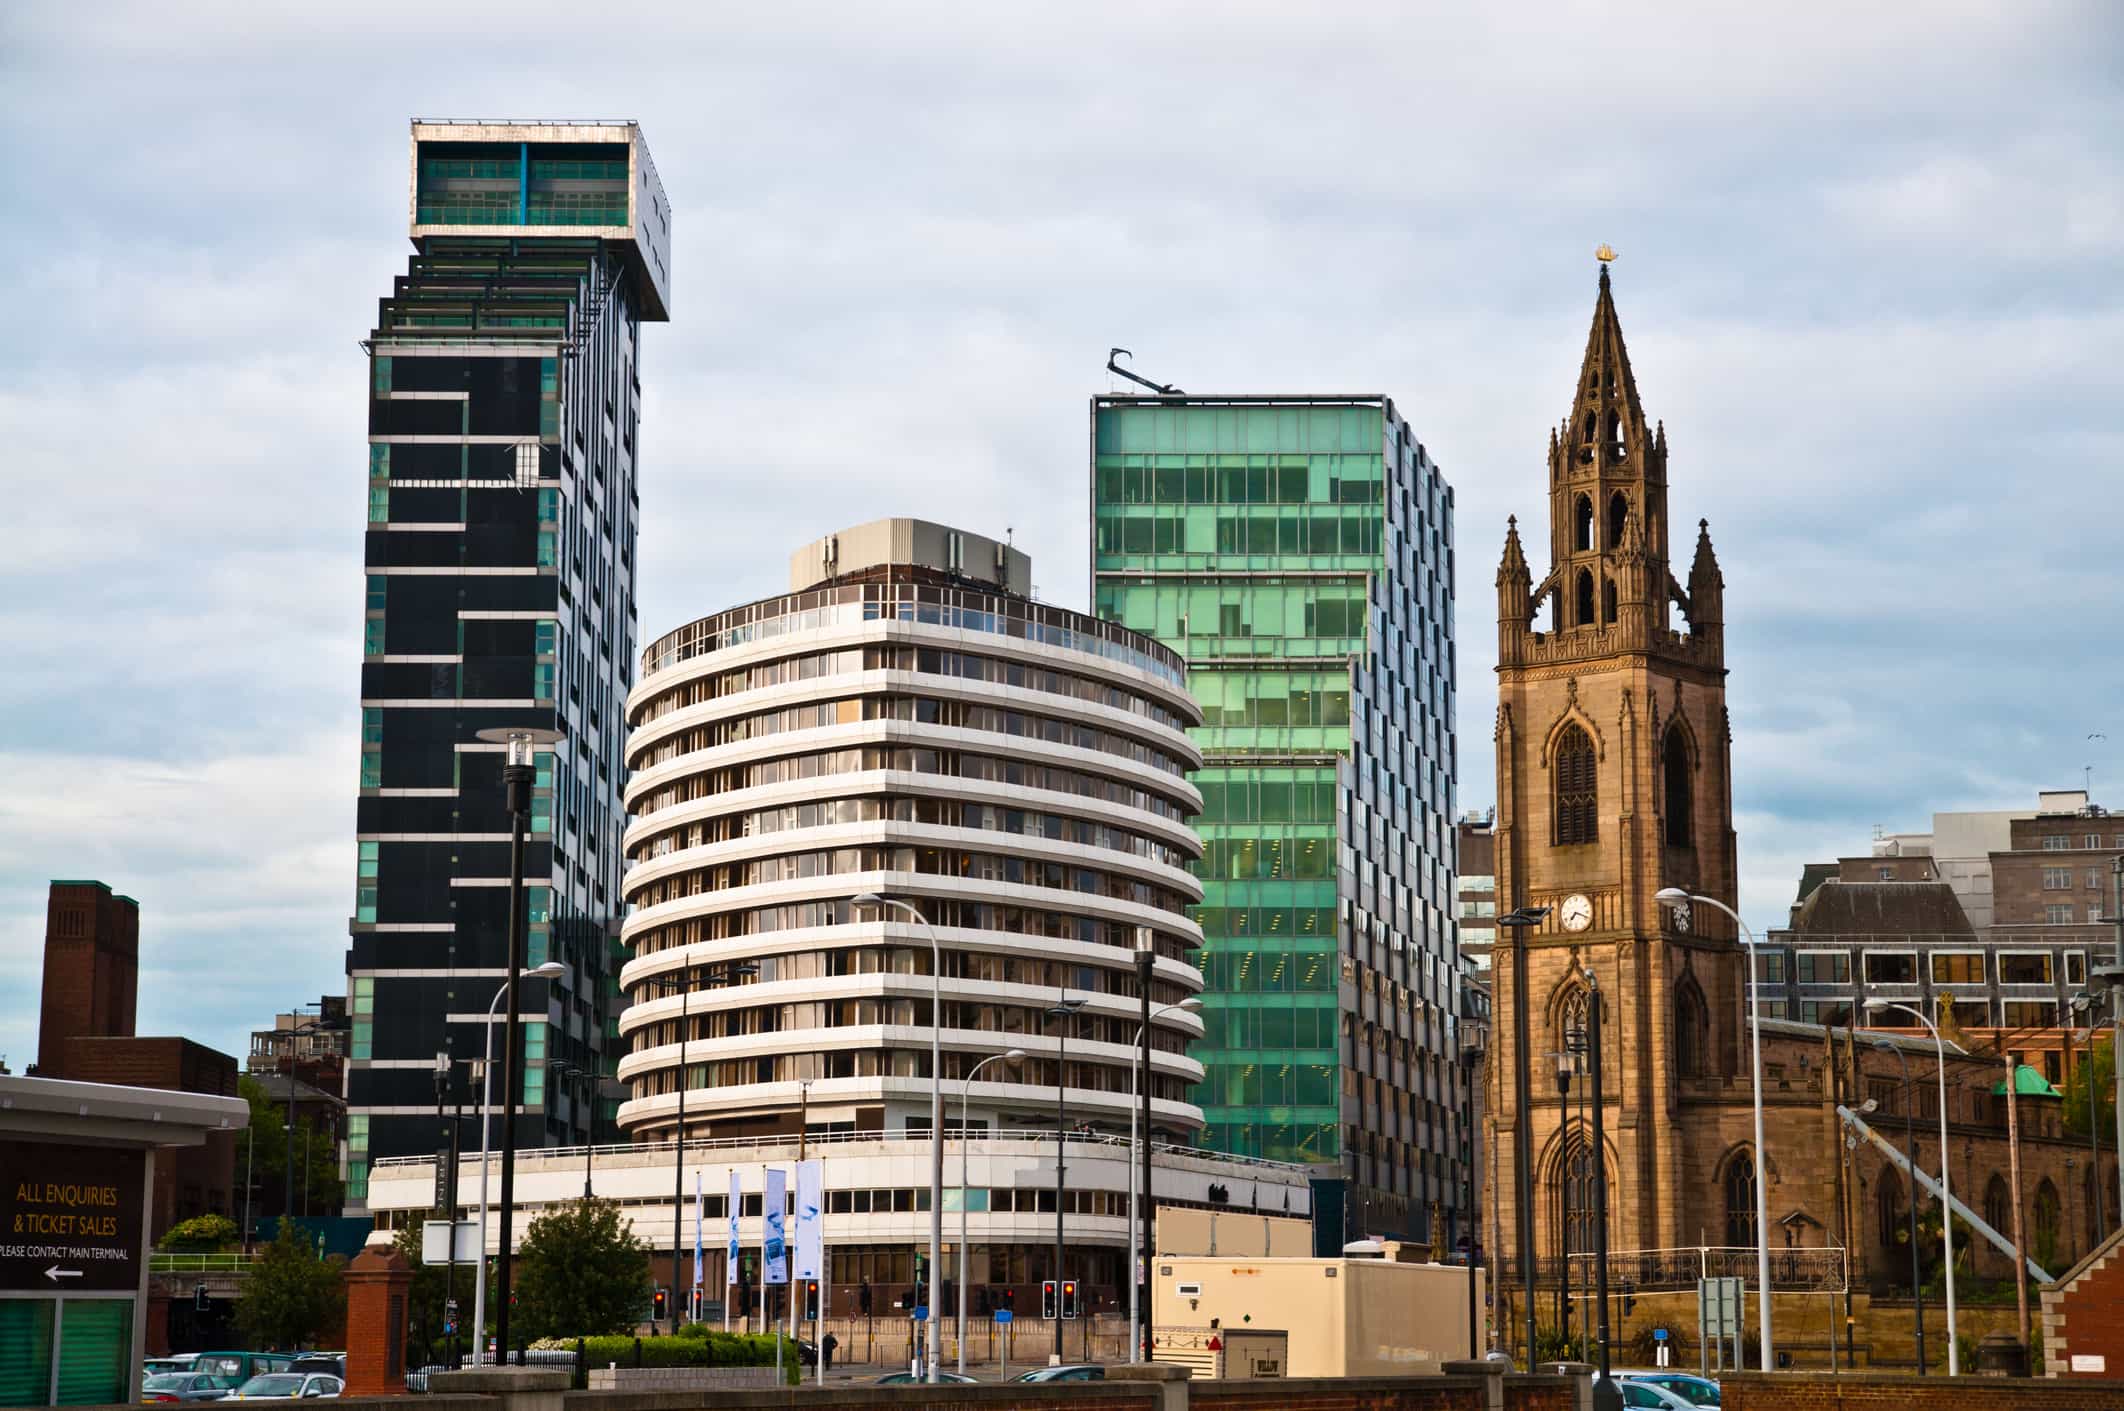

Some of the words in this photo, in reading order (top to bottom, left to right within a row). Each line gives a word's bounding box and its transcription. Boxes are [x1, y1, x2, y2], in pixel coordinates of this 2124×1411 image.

[16, 1183, 41, 1202] ALL
[46, 1184, 118, 1207] ENQUIRIES
[14, 1214, 24, 1233] &
[26, 1214, 76, 1234] TICKET
[79, 1216, 117, 1236] SALES
[26, 1246, 67, 1258] CONTACT
[69, 1247, 90, 1259] MAIN
[91, 1247, 128, 1260] TERMINAL
